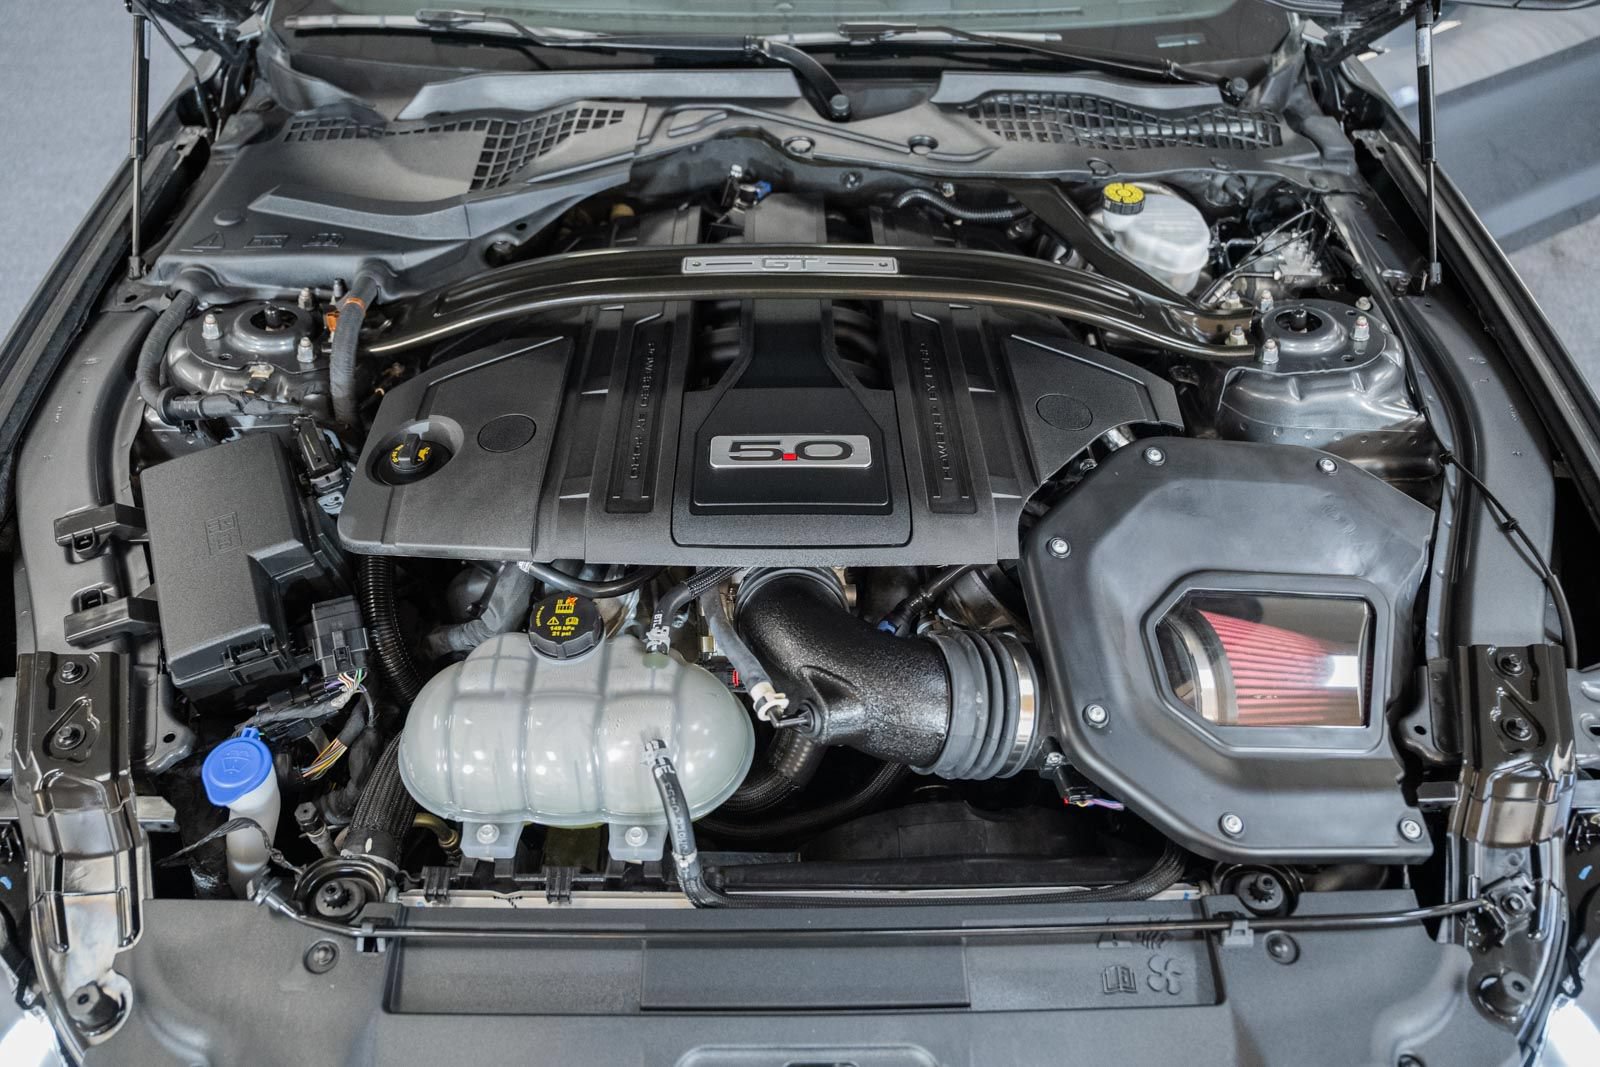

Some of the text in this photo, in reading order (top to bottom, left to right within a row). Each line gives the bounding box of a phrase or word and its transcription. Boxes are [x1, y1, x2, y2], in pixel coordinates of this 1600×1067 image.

[761, 257, 818, 269] GT
[640, 342, 655, 407] POWERED
[635, 412, 646, 431] BY
[919, 343, 952, 480] POWERED BY FORD
[728, 439, 853, 461] 5.0
